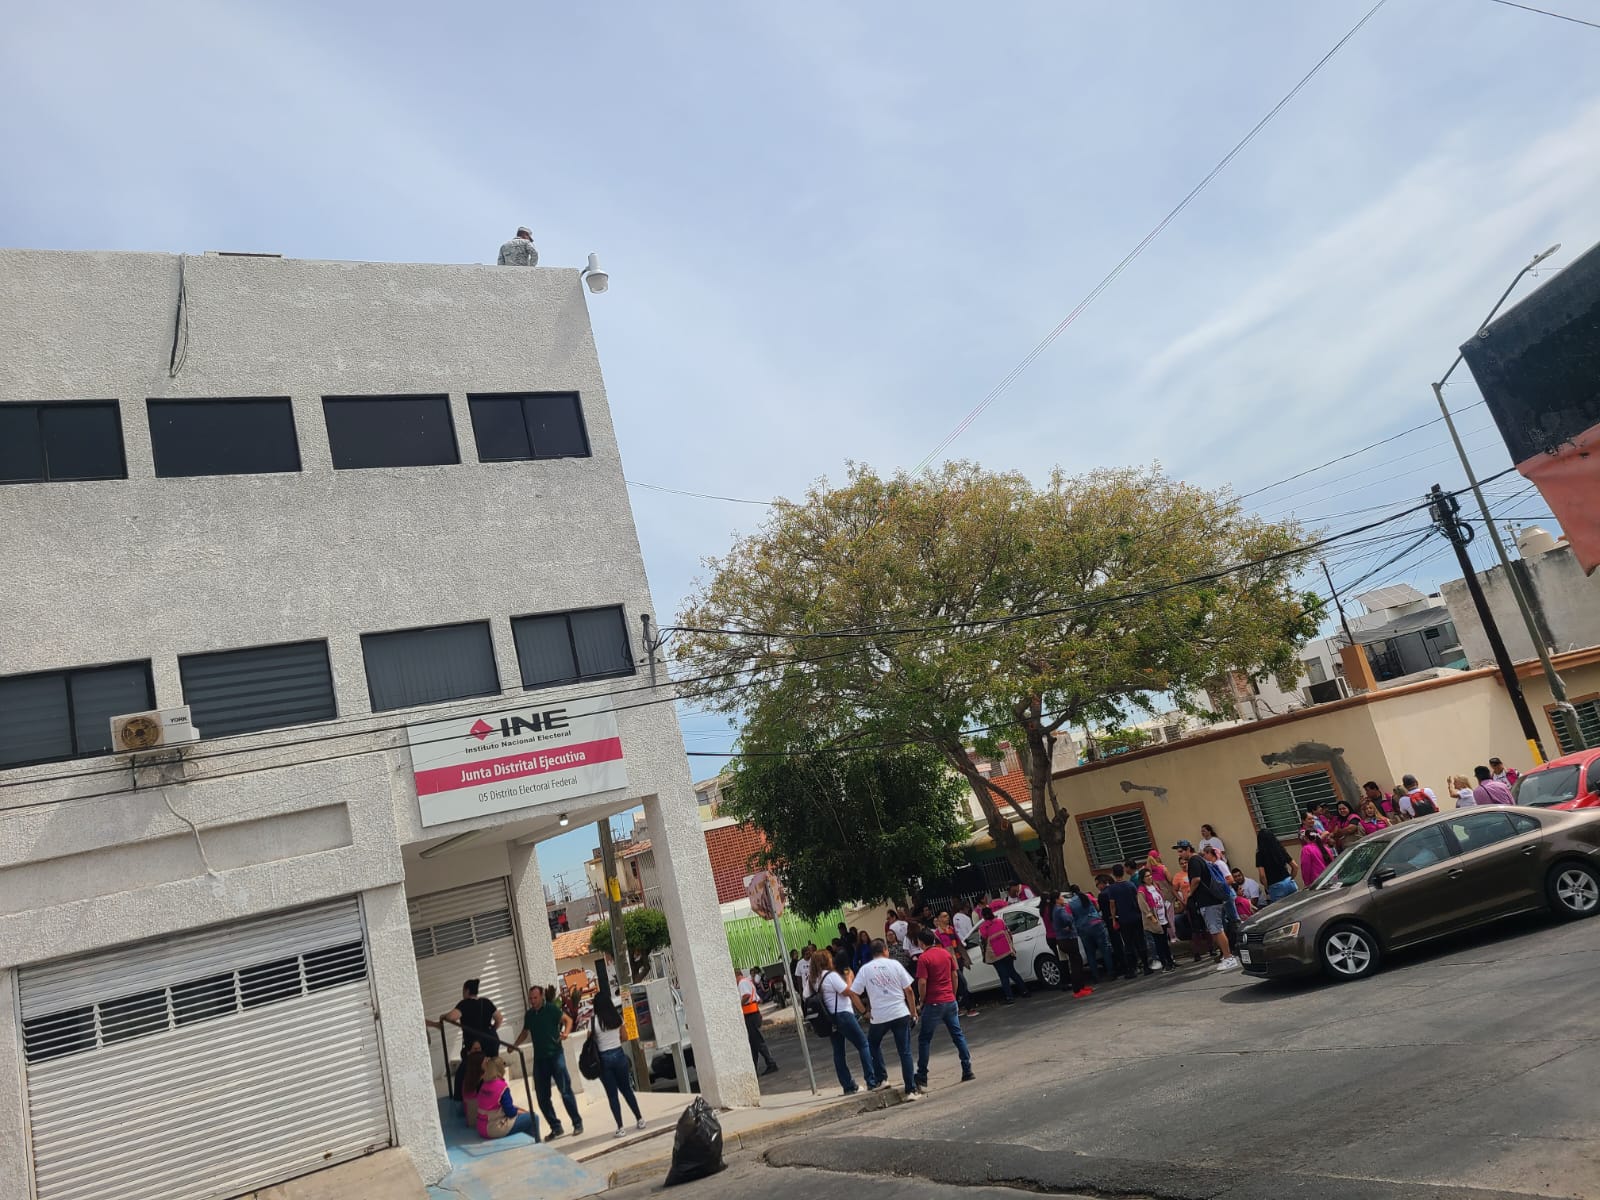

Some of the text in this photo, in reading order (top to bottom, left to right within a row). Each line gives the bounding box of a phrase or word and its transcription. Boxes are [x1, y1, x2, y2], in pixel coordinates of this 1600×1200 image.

[500, 708, 569, 737] INE
[465, 730, 572, 754] Instituto Nacional Electoral
[461, 751, 586, 783] Junta Distrital Ejecutiva
[478, 775, 578, 803] 05 Distrito Electoral Federal
